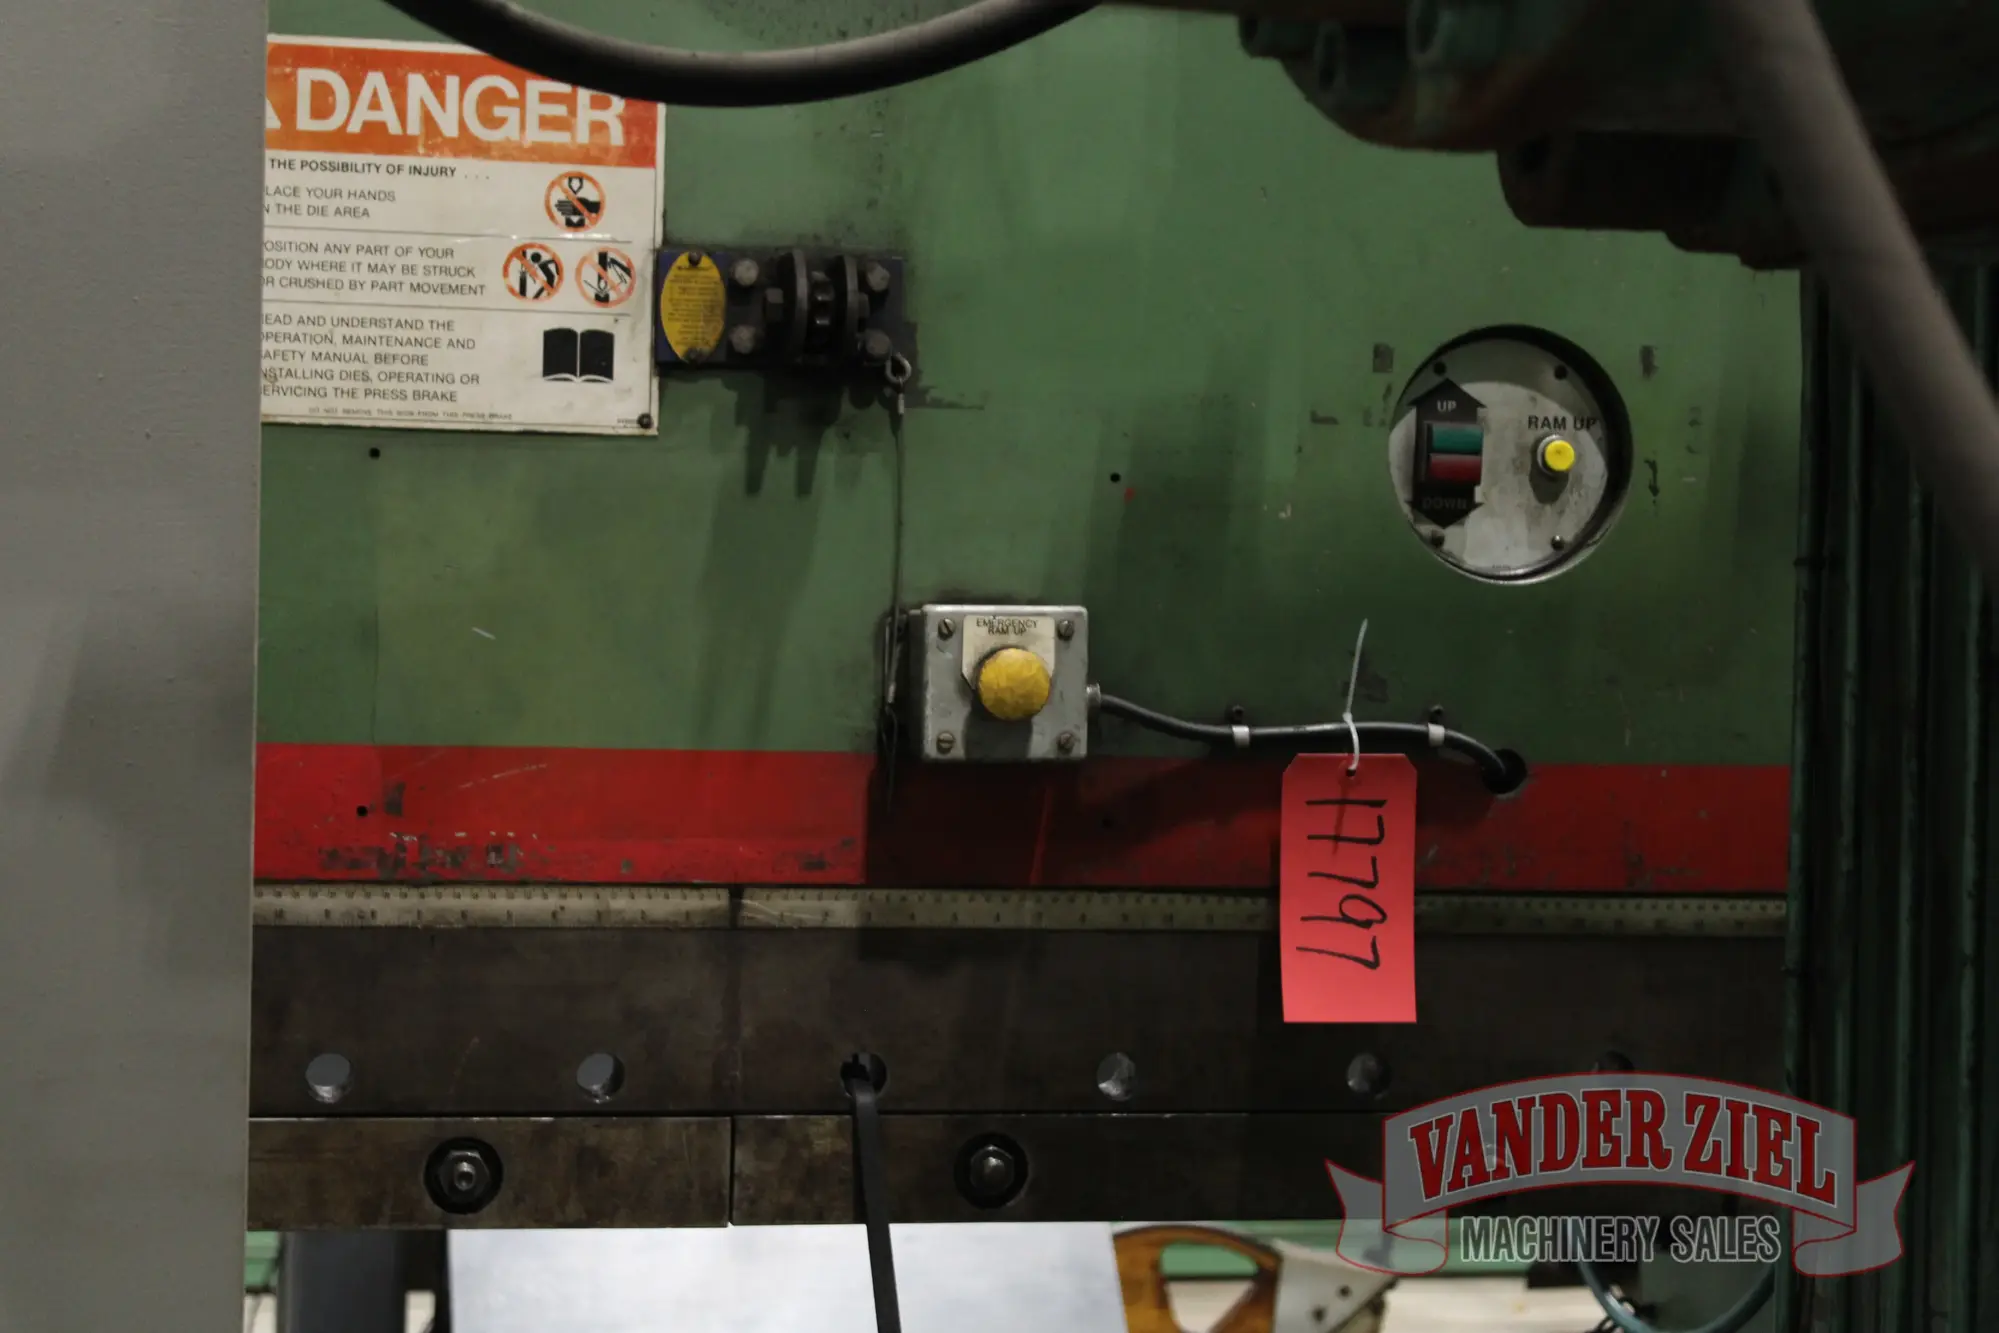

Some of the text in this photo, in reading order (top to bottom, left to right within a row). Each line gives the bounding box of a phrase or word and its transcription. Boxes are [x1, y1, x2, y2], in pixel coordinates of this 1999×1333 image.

[296, 67, 625, 147] DANGER
[269, 158, 297, 171] THE
[300, 160, 383, 174] POSSIBILITY
[385, 163, 405, 175] OF
[408, 165, 457, 178] INJURY
[264, 185, 397, 202] LACE YOUR HANDS
[275, 203, 303, 216] THE
[307, 205, 330, 217] DIE
[333, 206, 371, 219] AREA
[264, 240, 455, 260] OSITION ANY PART OF YOUR
[264, 258, 477, 279] ODY WHERE IT MAY BE STRUCK
[278, 276, 345, 291] CRUSHED
[348, 279, 367, 291] BY
[370, 280, 404, 293] PART
[409, 281, 487, 297] MOVEMENT
[296, 315, 327, 327] AND
[330, 315, 425, 331] UNDERSTAND
[428, 319, 456, 331] THE
[341, 333, 442, 350] MAINTENANCE
[446, 337, 477, 350] AND
[262, 349, 429, 367] AFETY MANUAL BEFORE
[338, 369, 373, 384] DIES,
[376, 370, 456, 386] OPERATING
[459, 373, 481, 386] OR
[262, 384, 459, 403] ERVICING THE PRESS BRAKE
[1437, 400, 1457, 413] UP
[1527, 416, 1600, 431] RAM UP
[1422, 495, 1467, 510] DOWN
[976, 618, 1039, 629] EMERGENCY
[988, 626, 1027, 636] RAM UP
[1296, 799, 1387, 970] 17797
